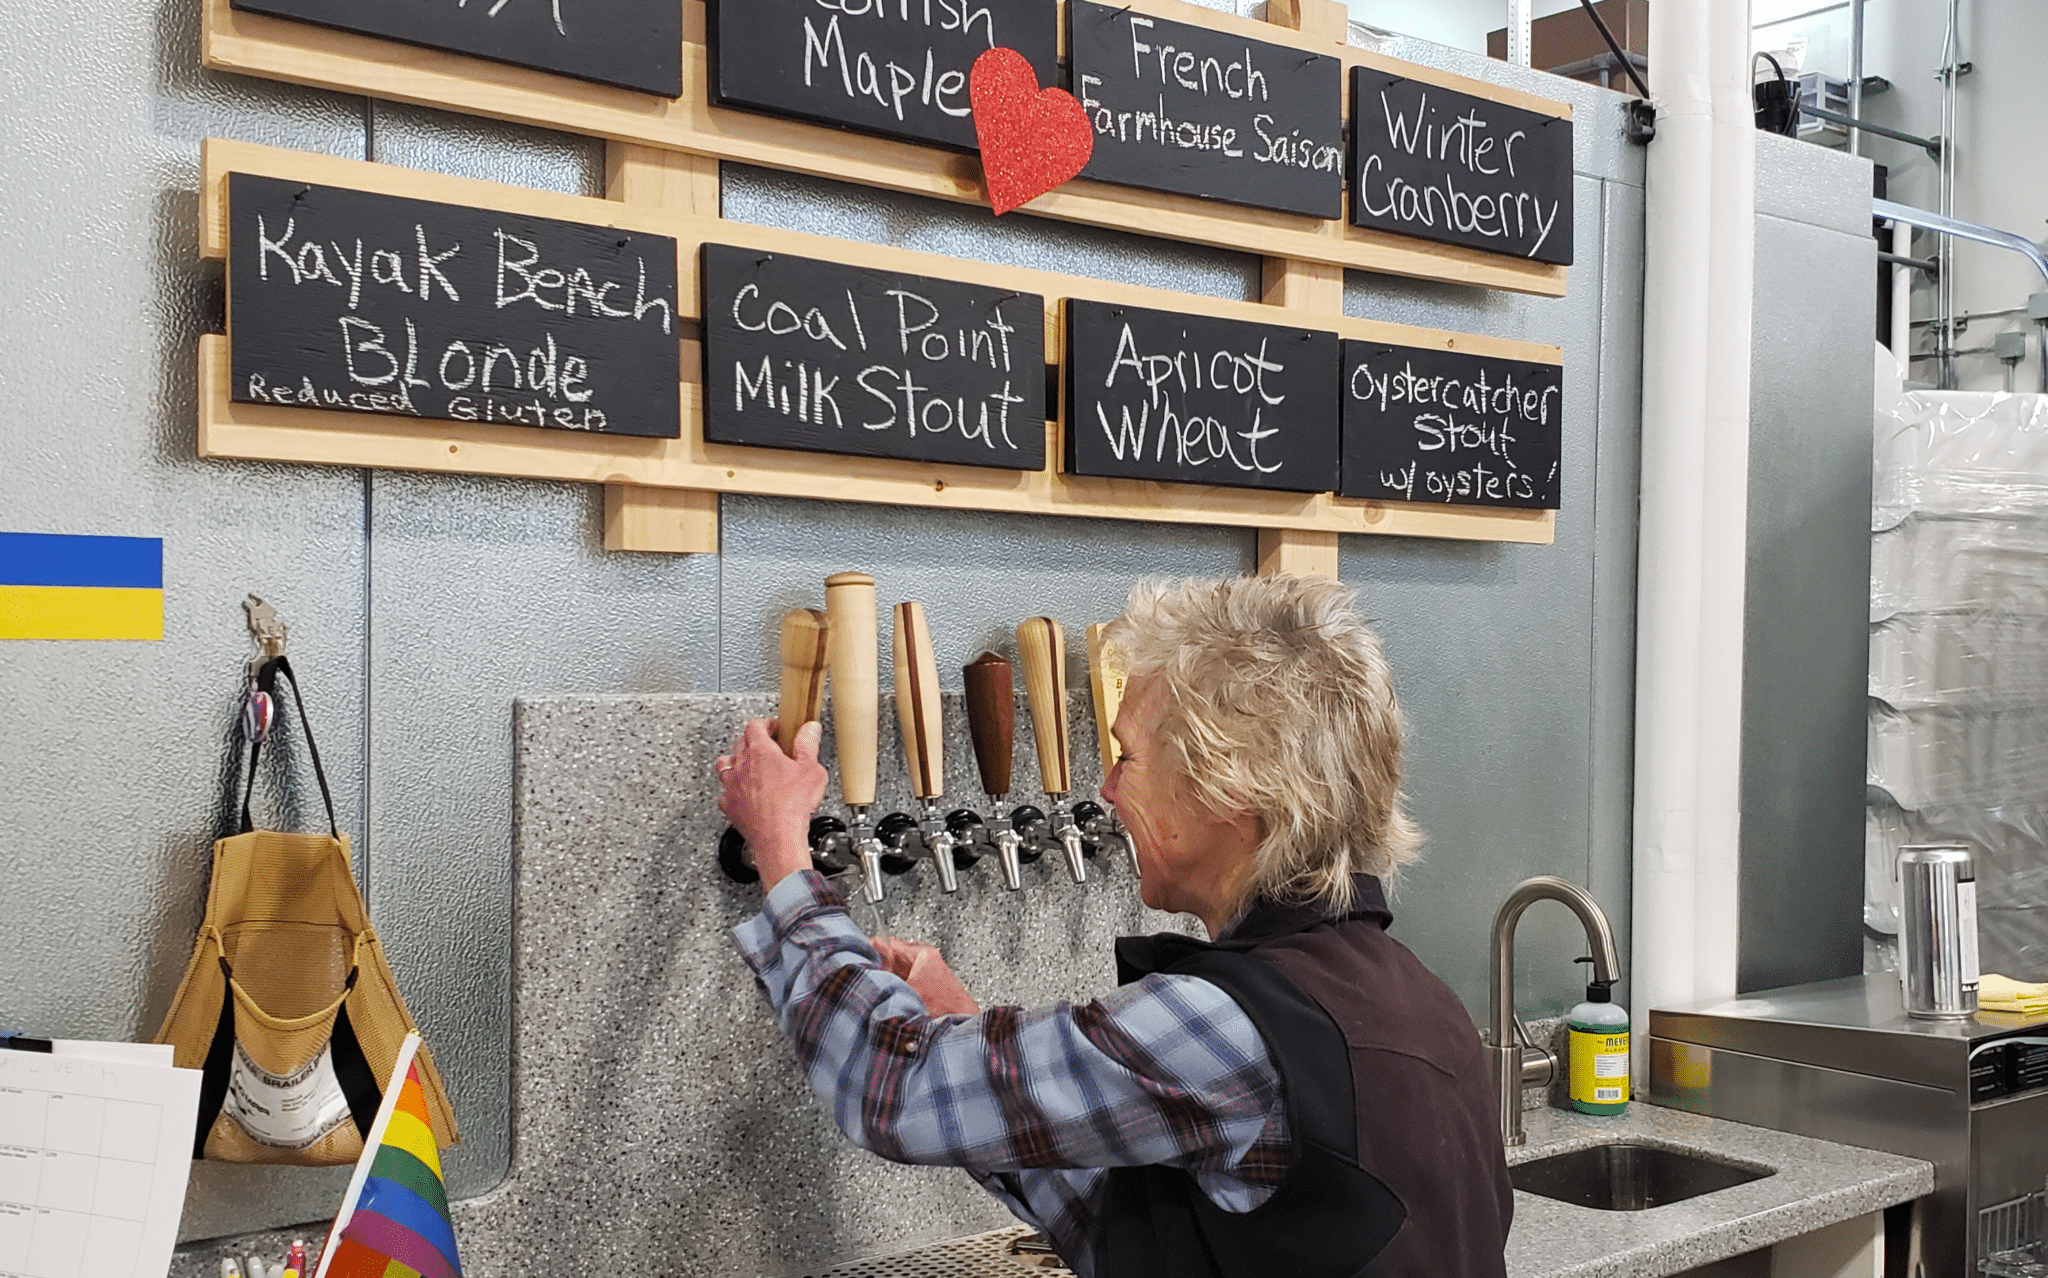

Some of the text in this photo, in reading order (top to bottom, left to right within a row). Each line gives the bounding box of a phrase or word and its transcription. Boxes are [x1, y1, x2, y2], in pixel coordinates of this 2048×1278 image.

[804, 14, 972, 121] Maple
[1130, 17, 1269, 102] French
[1081, 74, 1343, 176] Farmhouse Saison
[1380, 90, 1526, 178] Winter
[1362, 154, 1559, 258] Cranberry
[257, 213, 460, 310] Kayak
[732, 284, 1015, 373] Coal Point
[1105, 322, 1286, 411] Apricot
[249, 372, 608, 431] Reduced Gluten
[735, 354, 1026, 450] Milk Stout
[1096, 390, 1285, 473] Wheat
[1351, 360, 1558, 425] Oystercatcher
[1413, 413, 1517, 469] Stout
